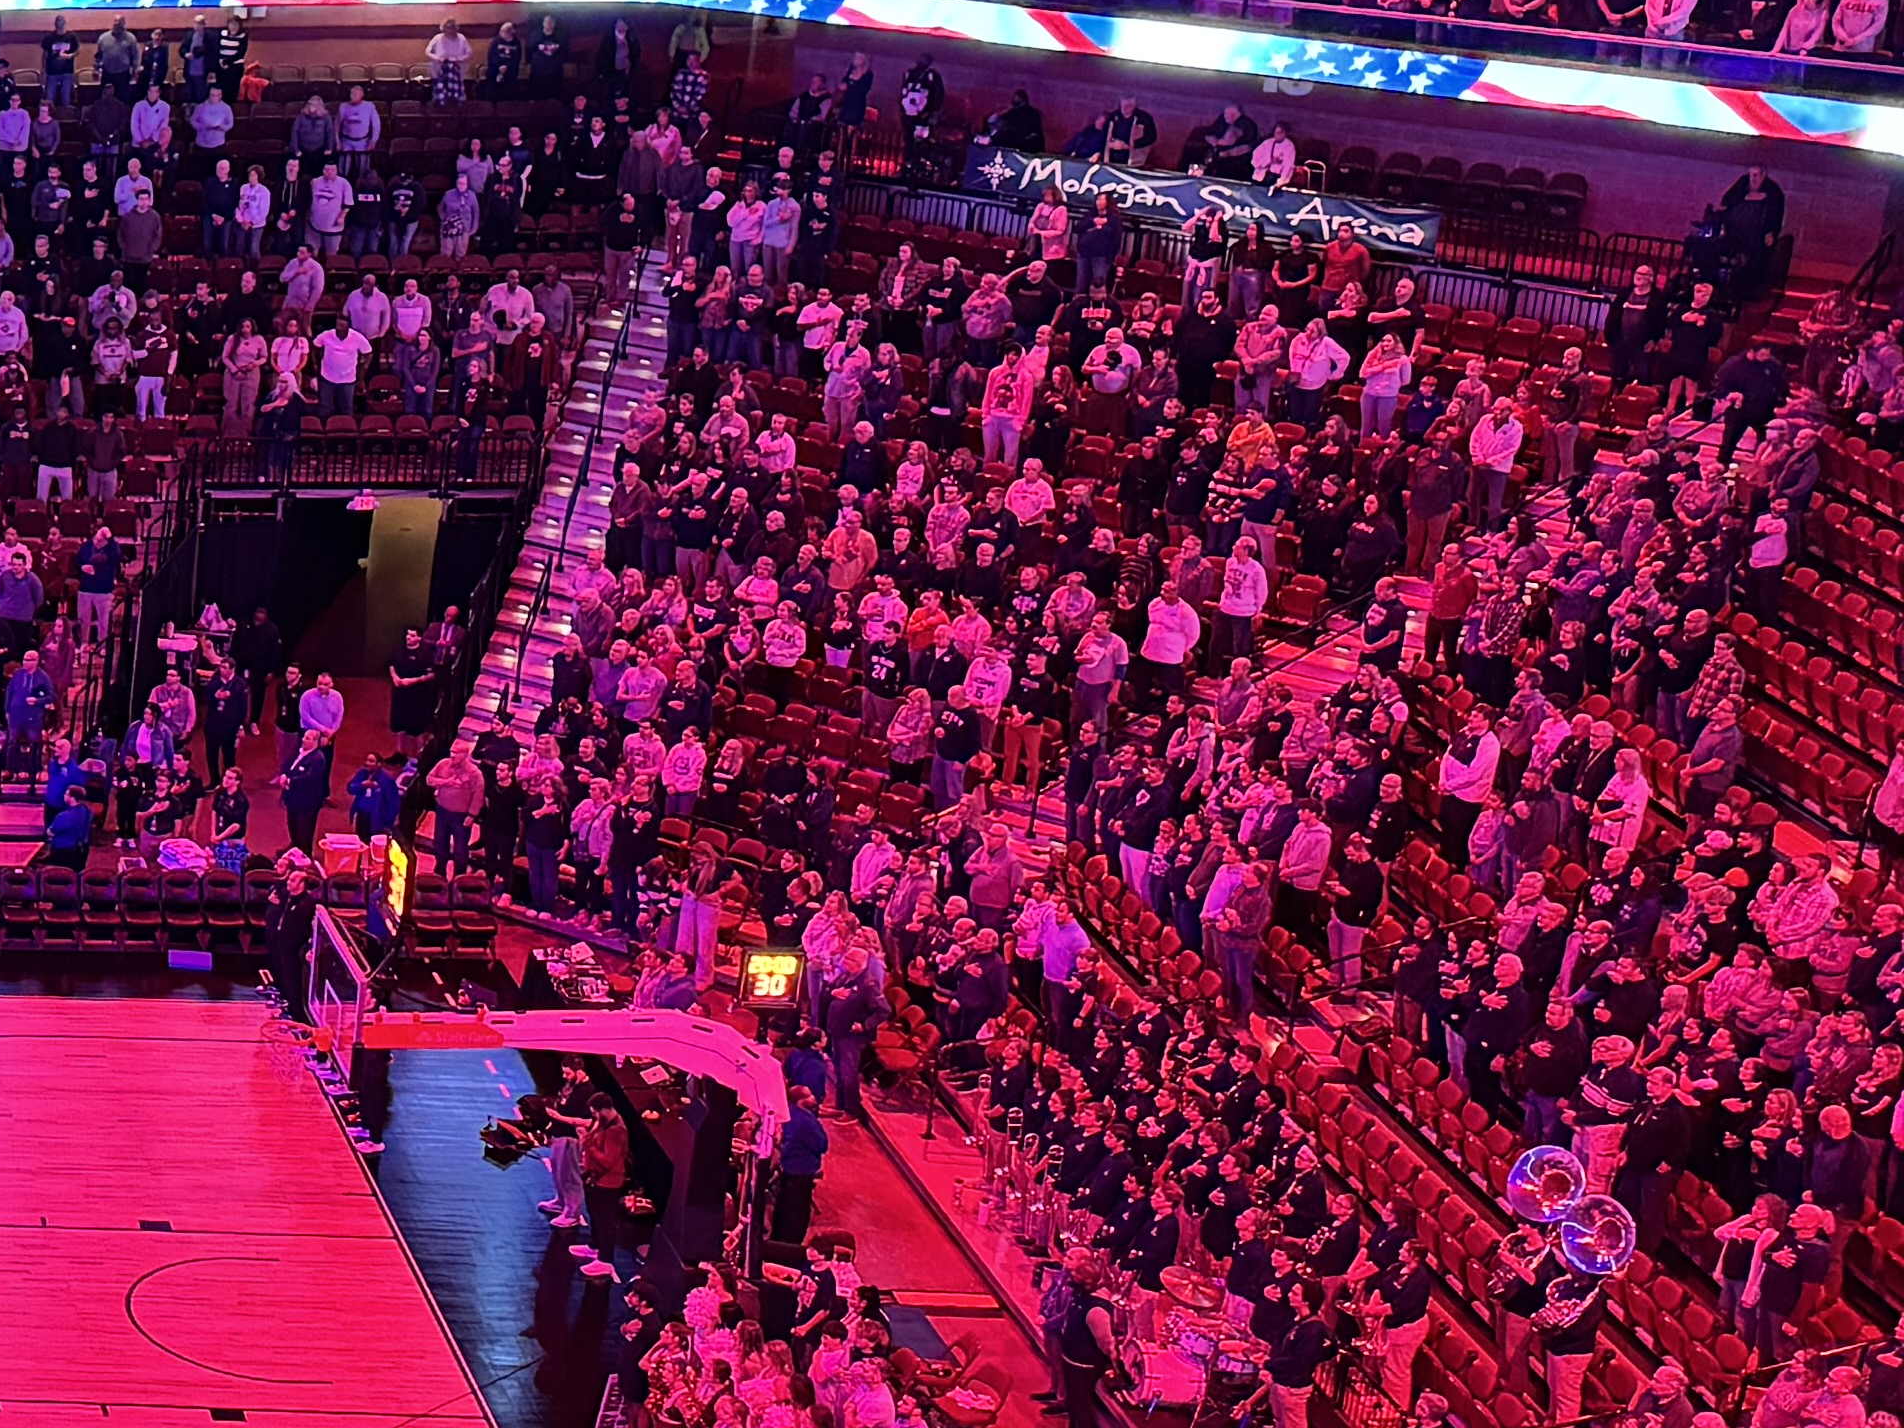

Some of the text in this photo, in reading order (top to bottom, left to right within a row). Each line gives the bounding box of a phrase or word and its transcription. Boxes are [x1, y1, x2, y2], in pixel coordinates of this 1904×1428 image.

[1019, 160, 1425, 247] Mohegan Sun Arena
[754, 974, 787, 997] 30
